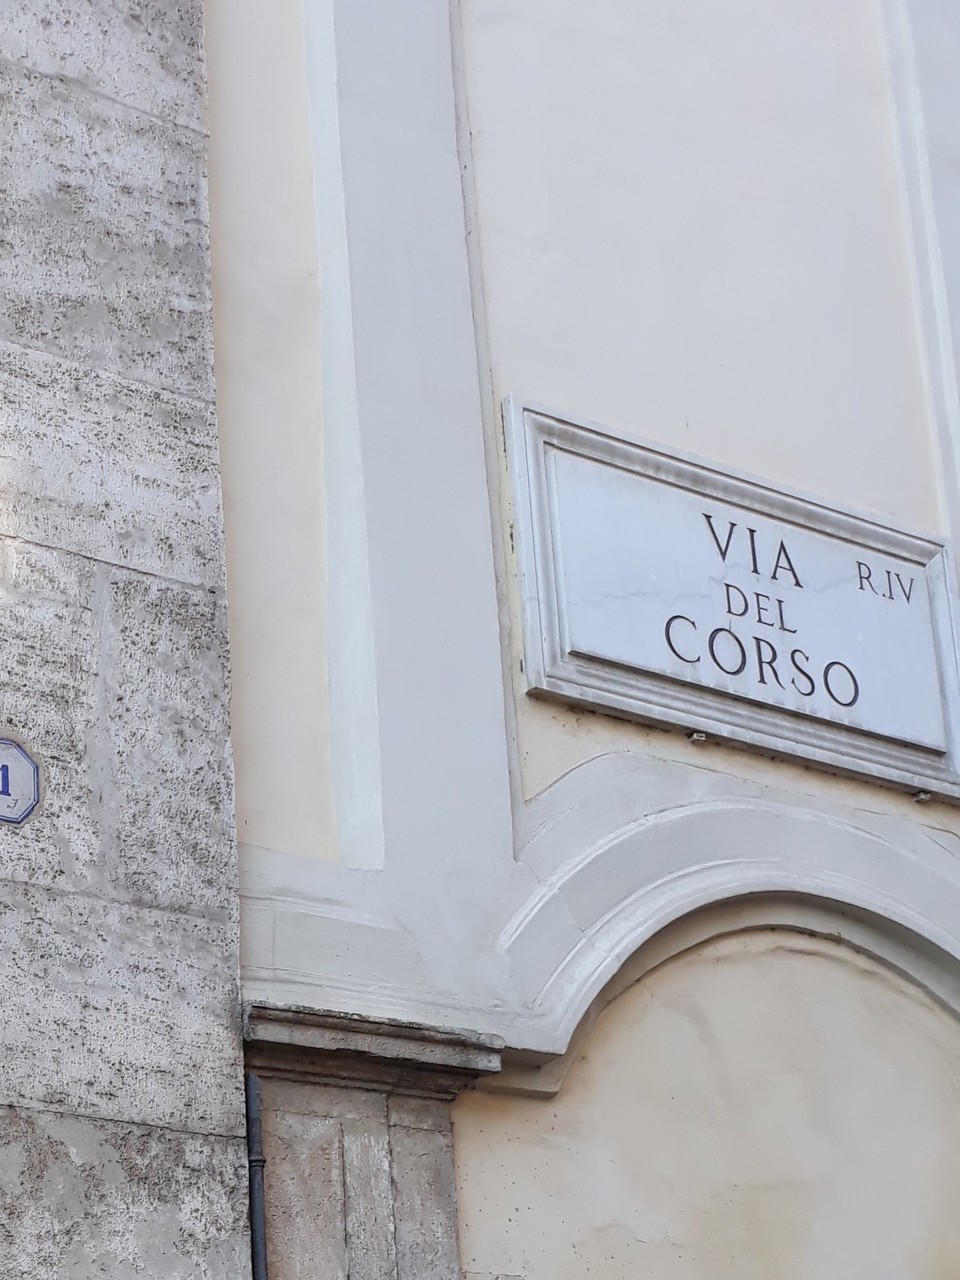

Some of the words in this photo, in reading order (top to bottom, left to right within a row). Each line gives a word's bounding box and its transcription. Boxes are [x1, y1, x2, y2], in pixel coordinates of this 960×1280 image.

[701, 513, 803, 588] VIA
[723, 583, 797, 633] DEL
[664, 614, 859, 707] CORSO
